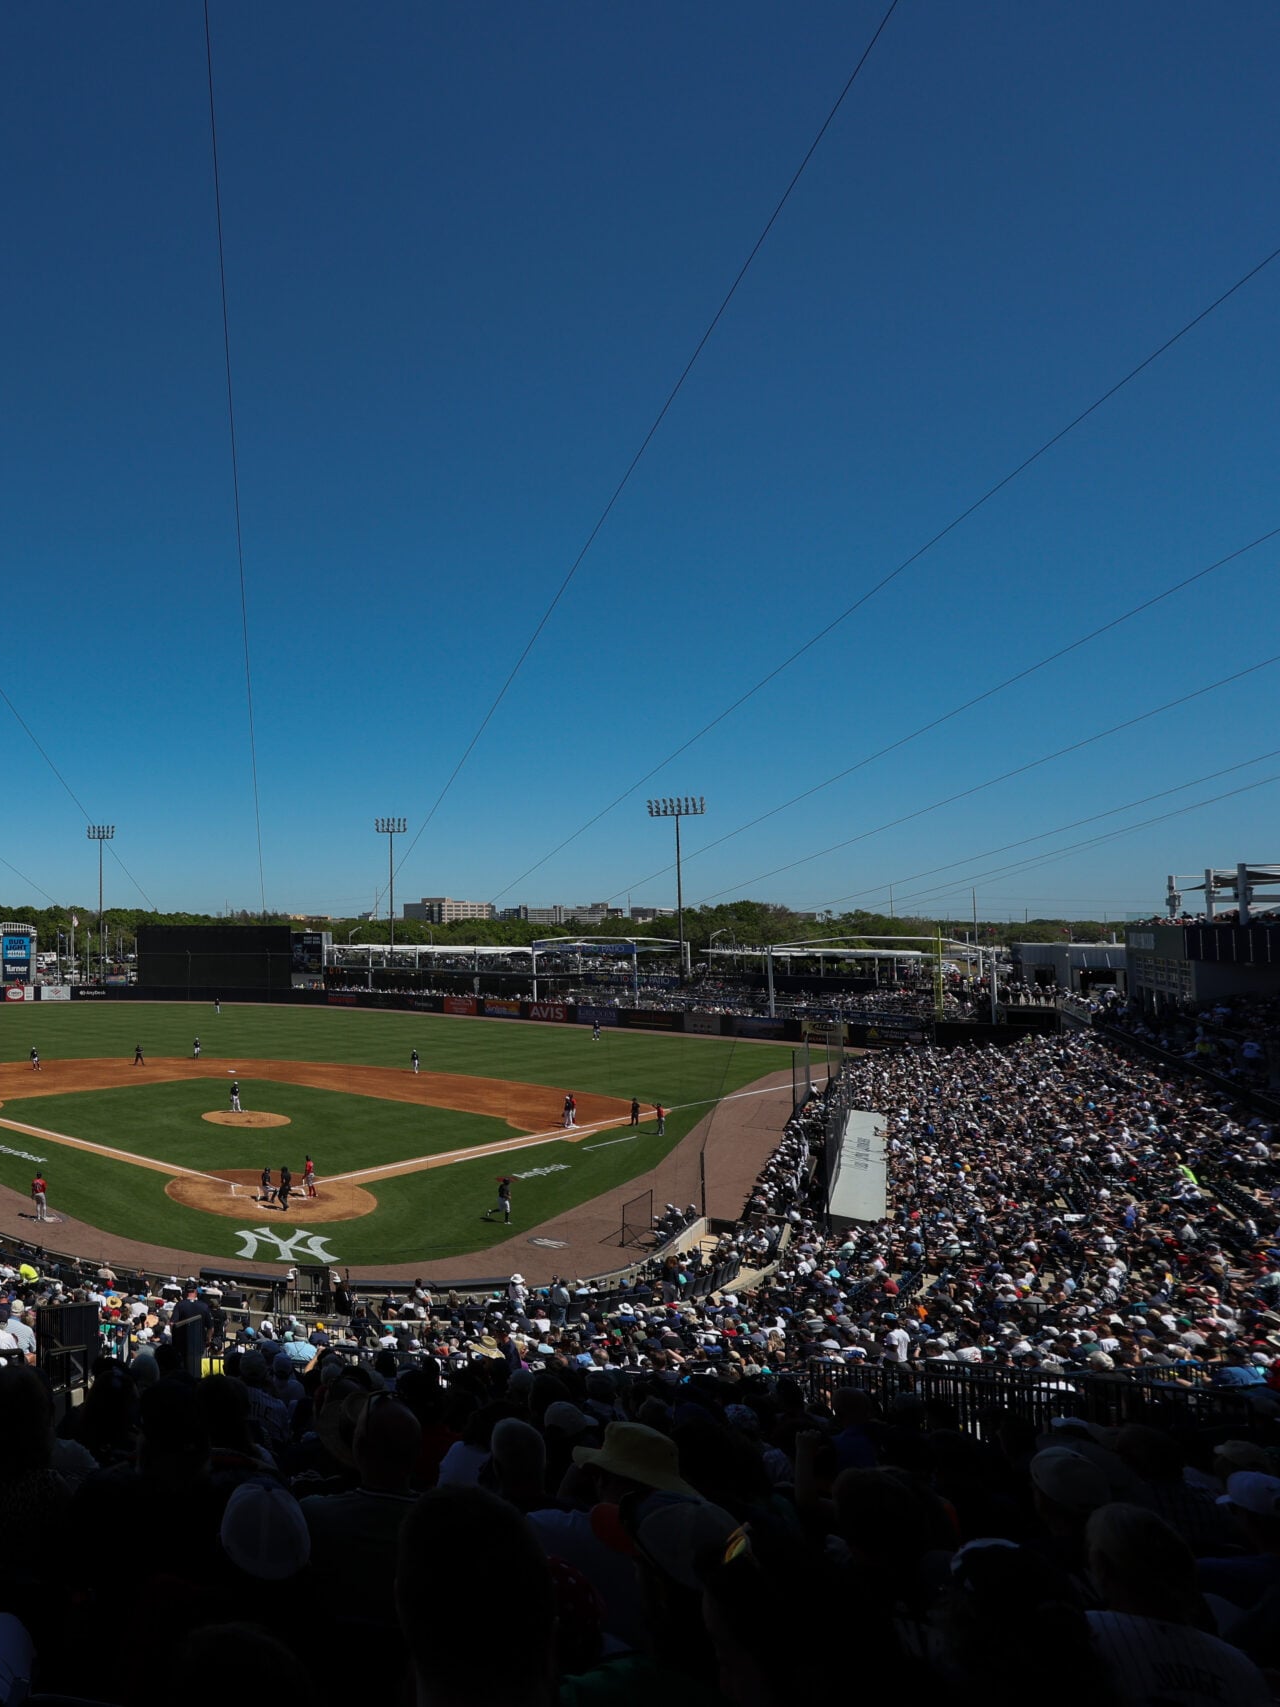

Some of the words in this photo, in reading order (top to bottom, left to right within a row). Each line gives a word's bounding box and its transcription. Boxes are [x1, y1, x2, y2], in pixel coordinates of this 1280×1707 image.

[601, 945, 625, 953] PATIO
[5, 964, 28, 972] Turner
[649, 976, 670, 985] PATIO
[530, 1006, 564, 1020] AVIS
[578, 1007, 617, 1018] LECOM
[233, 1226, 341, 1264] NY
